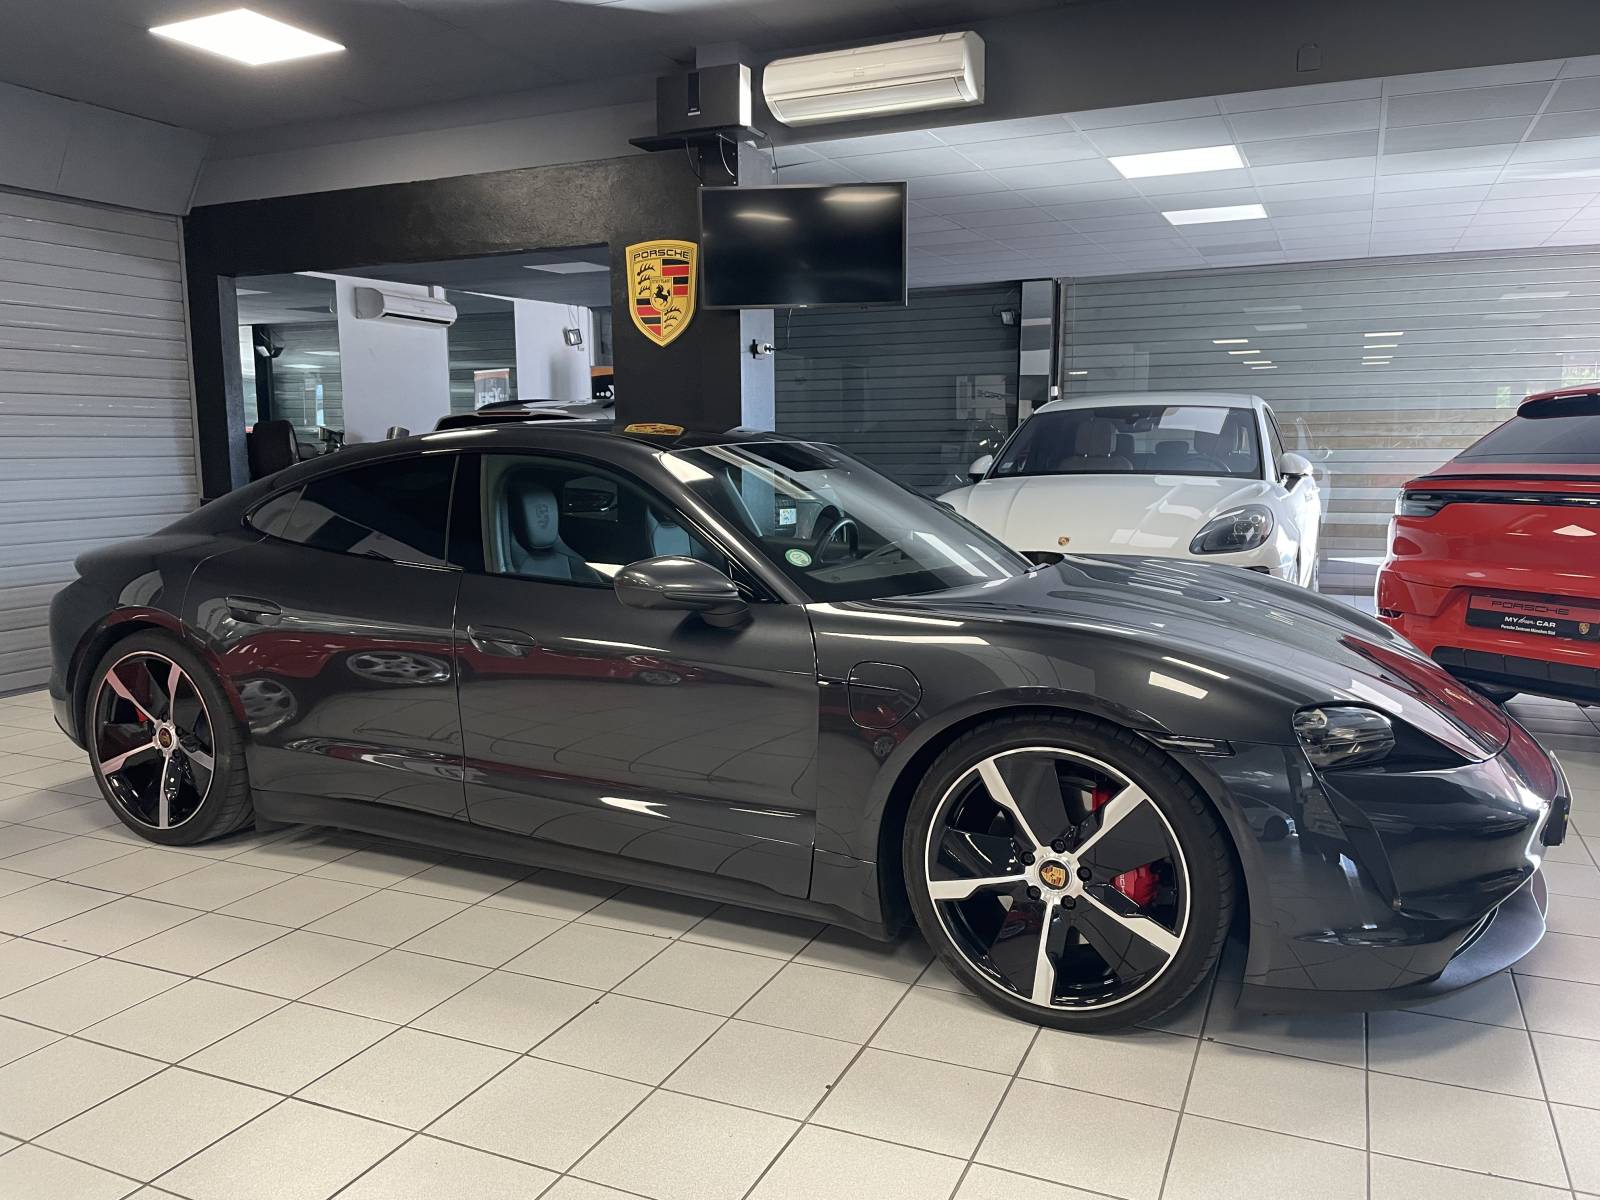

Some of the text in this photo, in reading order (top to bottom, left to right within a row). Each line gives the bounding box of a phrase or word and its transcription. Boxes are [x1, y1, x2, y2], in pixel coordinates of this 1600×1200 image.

[633, 249, 690, 261] PORSCHE
[1491, 601, 1569, 615] PORSCHE
[1536, 620, 1556, 628] CAR
